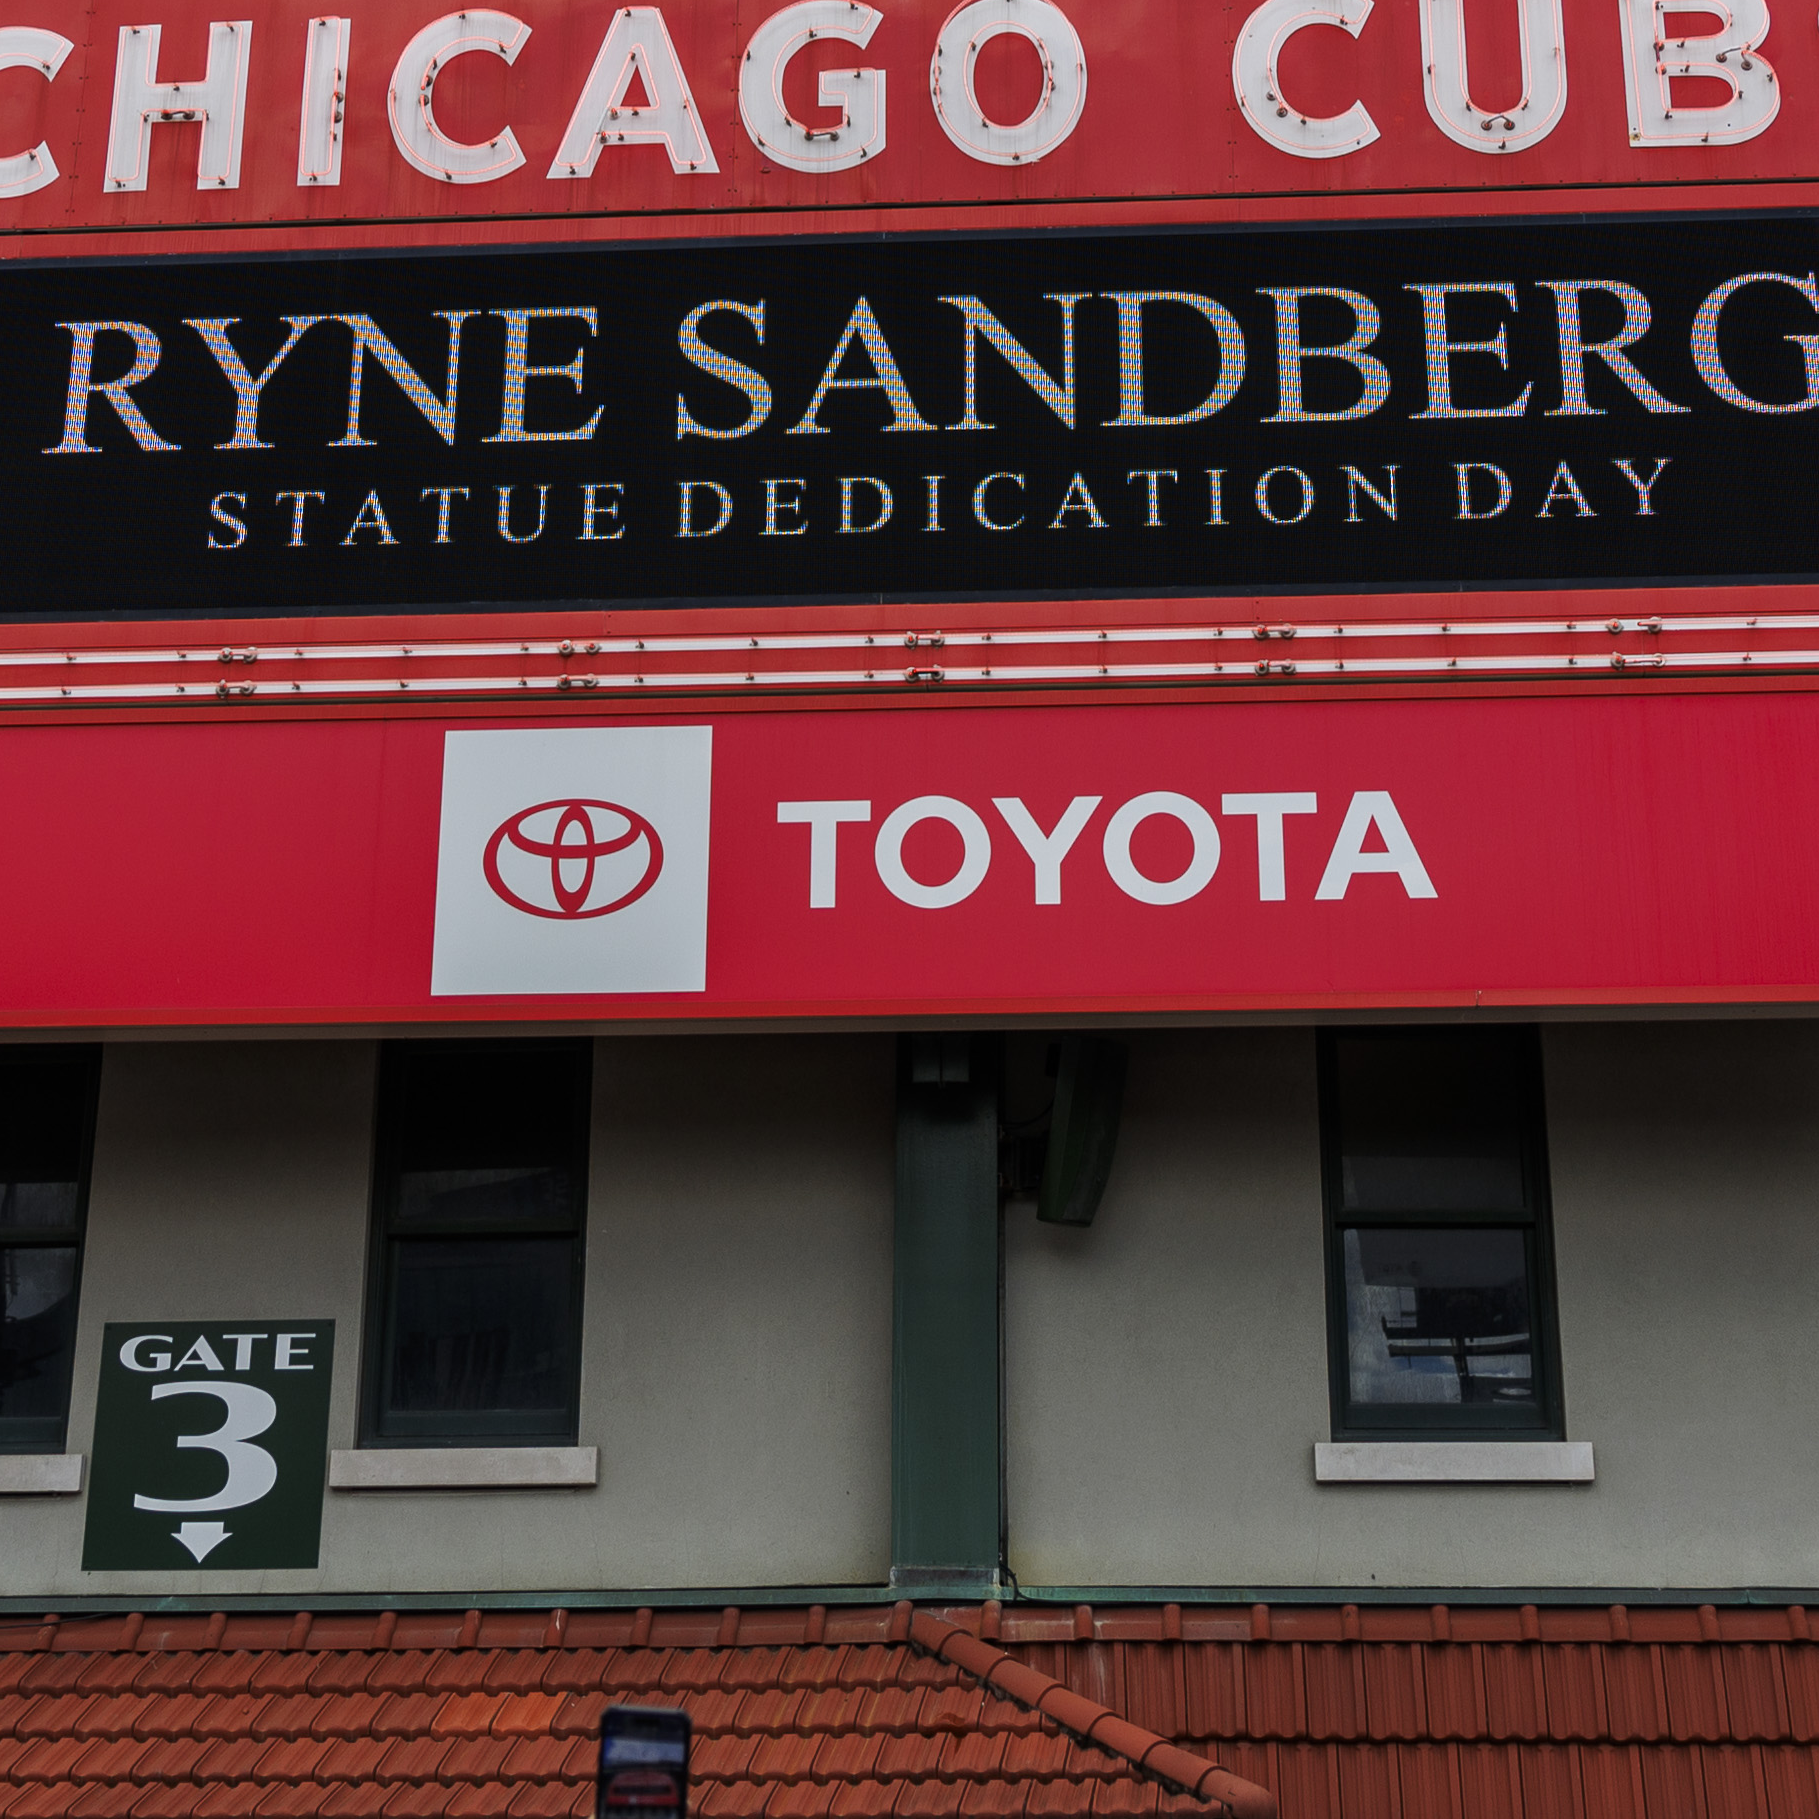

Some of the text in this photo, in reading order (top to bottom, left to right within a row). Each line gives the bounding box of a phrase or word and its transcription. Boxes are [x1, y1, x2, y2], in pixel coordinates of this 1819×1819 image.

[42, 306, 604, 454] RYNE
[208, 459, 1665, 549] STATUE DEDICATION DAY
[777, 791, 1438, 908] TOYOTA
[120, 1333, 316, 1372] GATE
[134, 1381, 277, 1512] 3
